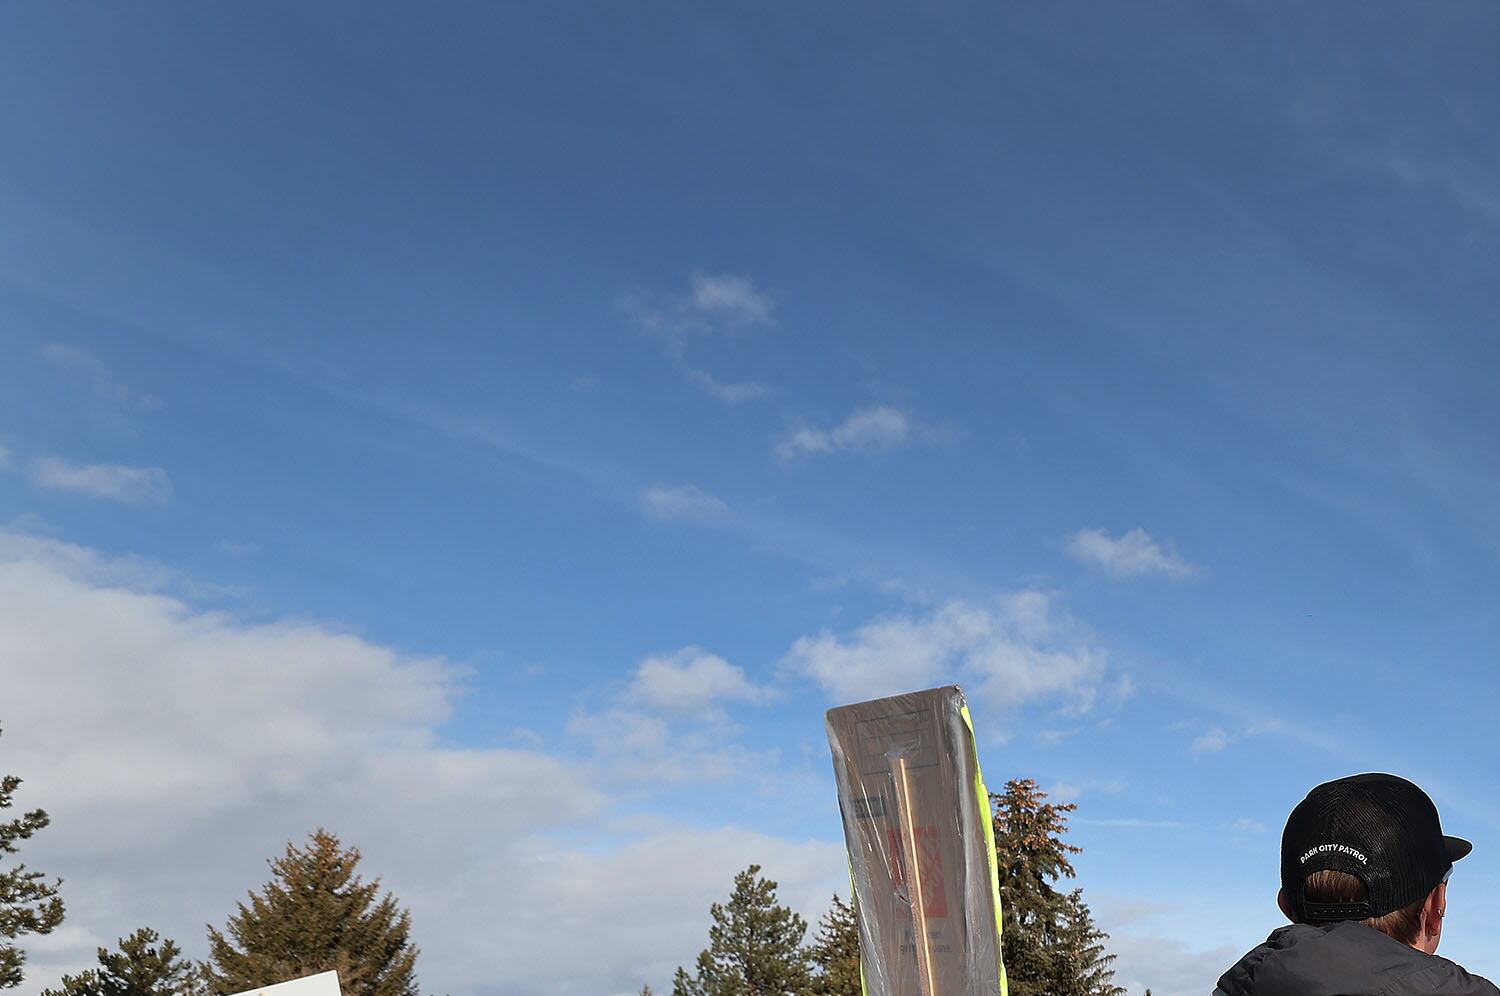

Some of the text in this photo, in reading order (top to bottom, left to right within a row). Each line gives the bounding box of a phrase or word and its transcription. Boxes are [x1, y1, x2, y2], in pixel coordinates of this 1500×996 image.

[1300, 844, 1368, 865] PARK CITY PATROL
